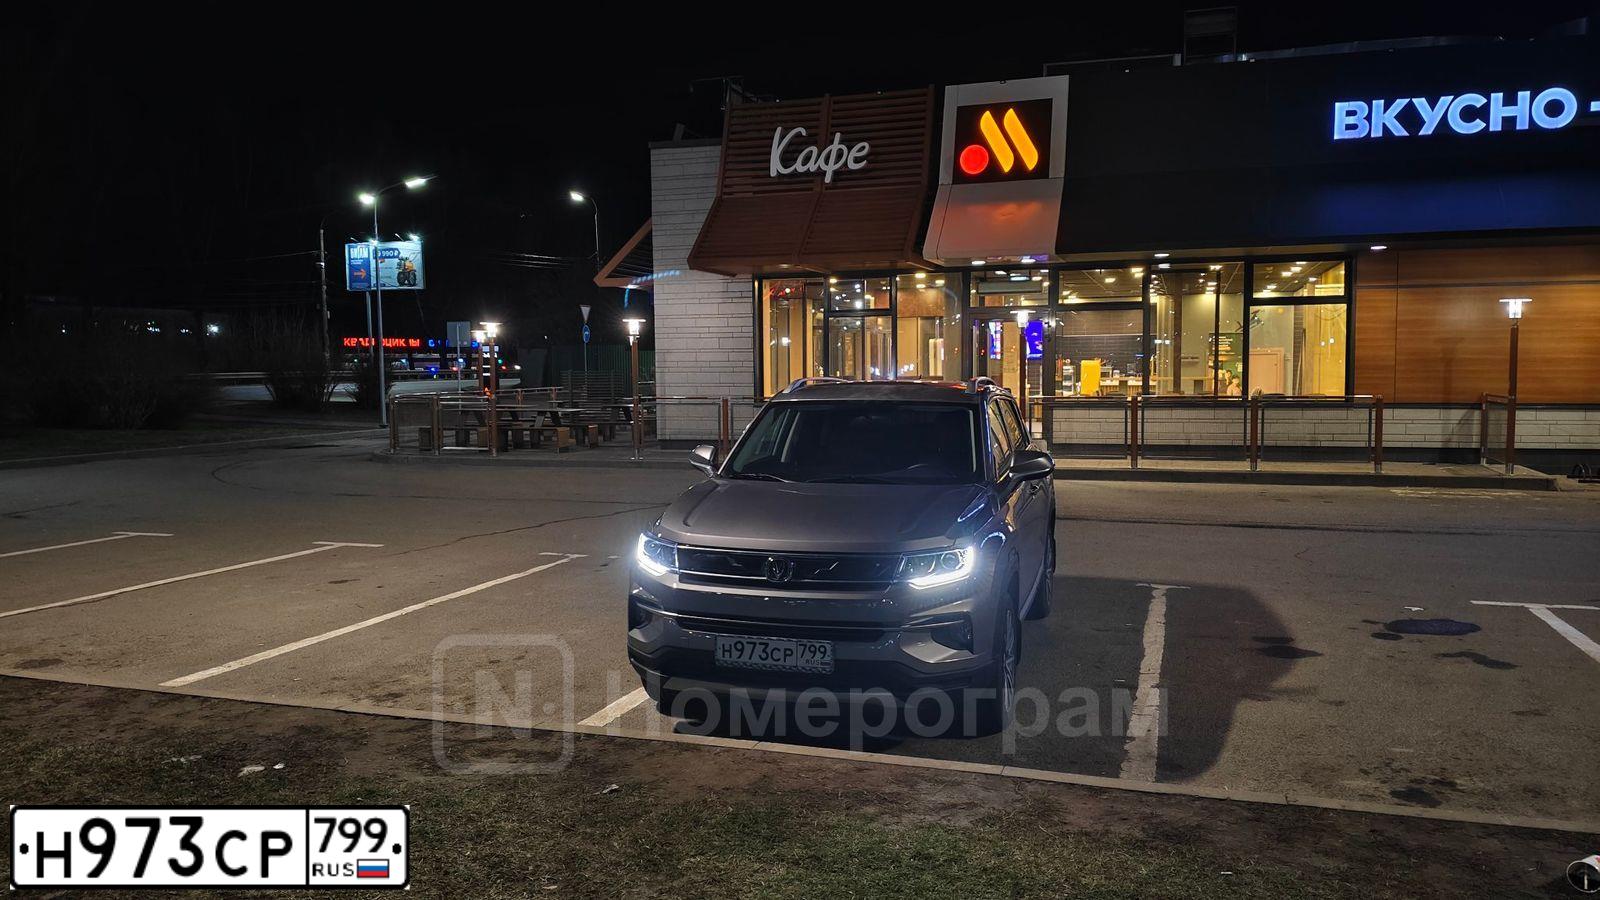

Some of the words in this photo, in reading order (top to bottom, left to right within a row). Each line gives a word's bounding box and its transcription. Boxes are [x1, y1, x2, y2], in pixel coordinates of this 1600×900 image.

[1333, 87, 1578, 140] ВКУСНО
[769, 126, 870, 183] Кафе
[721, 641, 794, 663] Н973СР
[799, 643, 827, 660] 799
